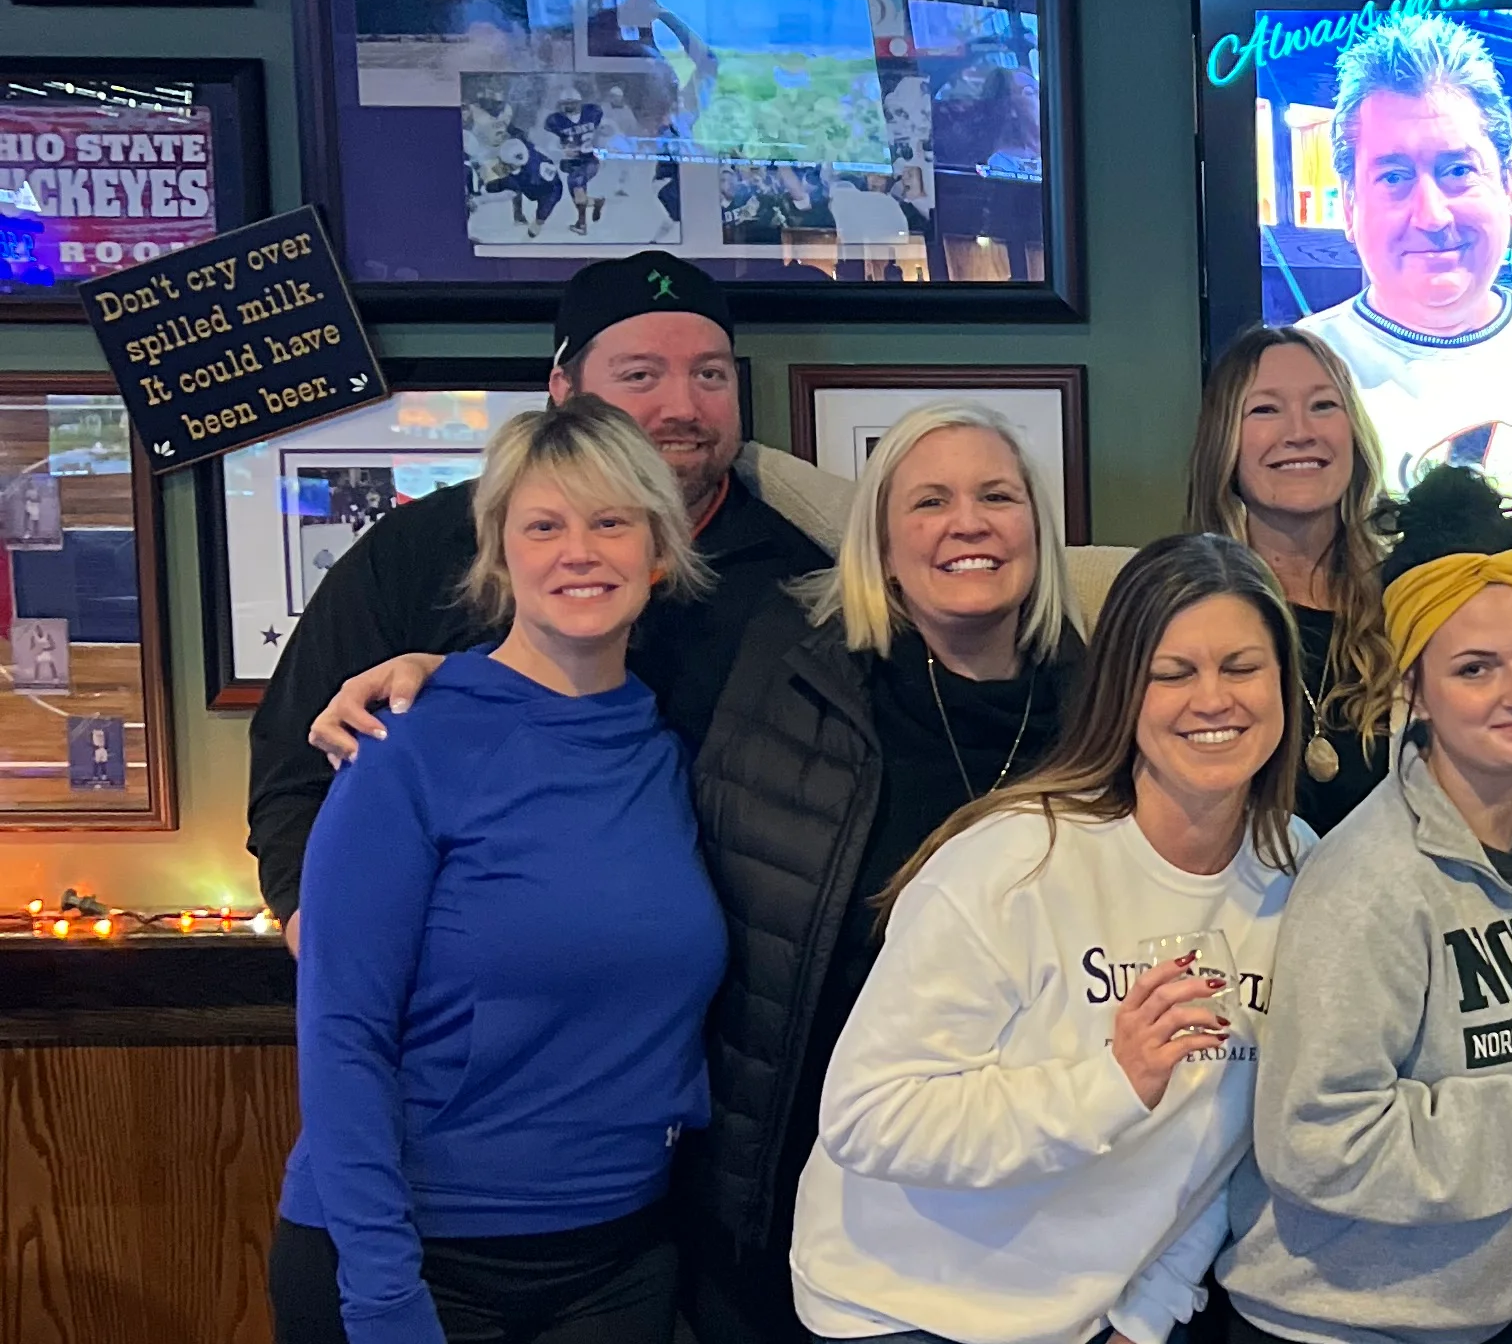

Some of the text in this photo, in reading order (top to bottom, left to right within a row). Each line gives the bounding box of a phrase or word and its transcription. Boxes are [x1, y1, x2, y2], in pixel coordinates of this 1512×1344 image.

[1206, 0, 1387, 87] Always
[75, 134, 207, 163] STATE
[95, 232, 313, 322] Don't cry over
[125, 279, 325, 367] spilled milk.
[139, 323, 342, 406] It could have
[181, 374, 338, 441] been beer.
[1186, 1046, 1259, 1063] ERDALE
